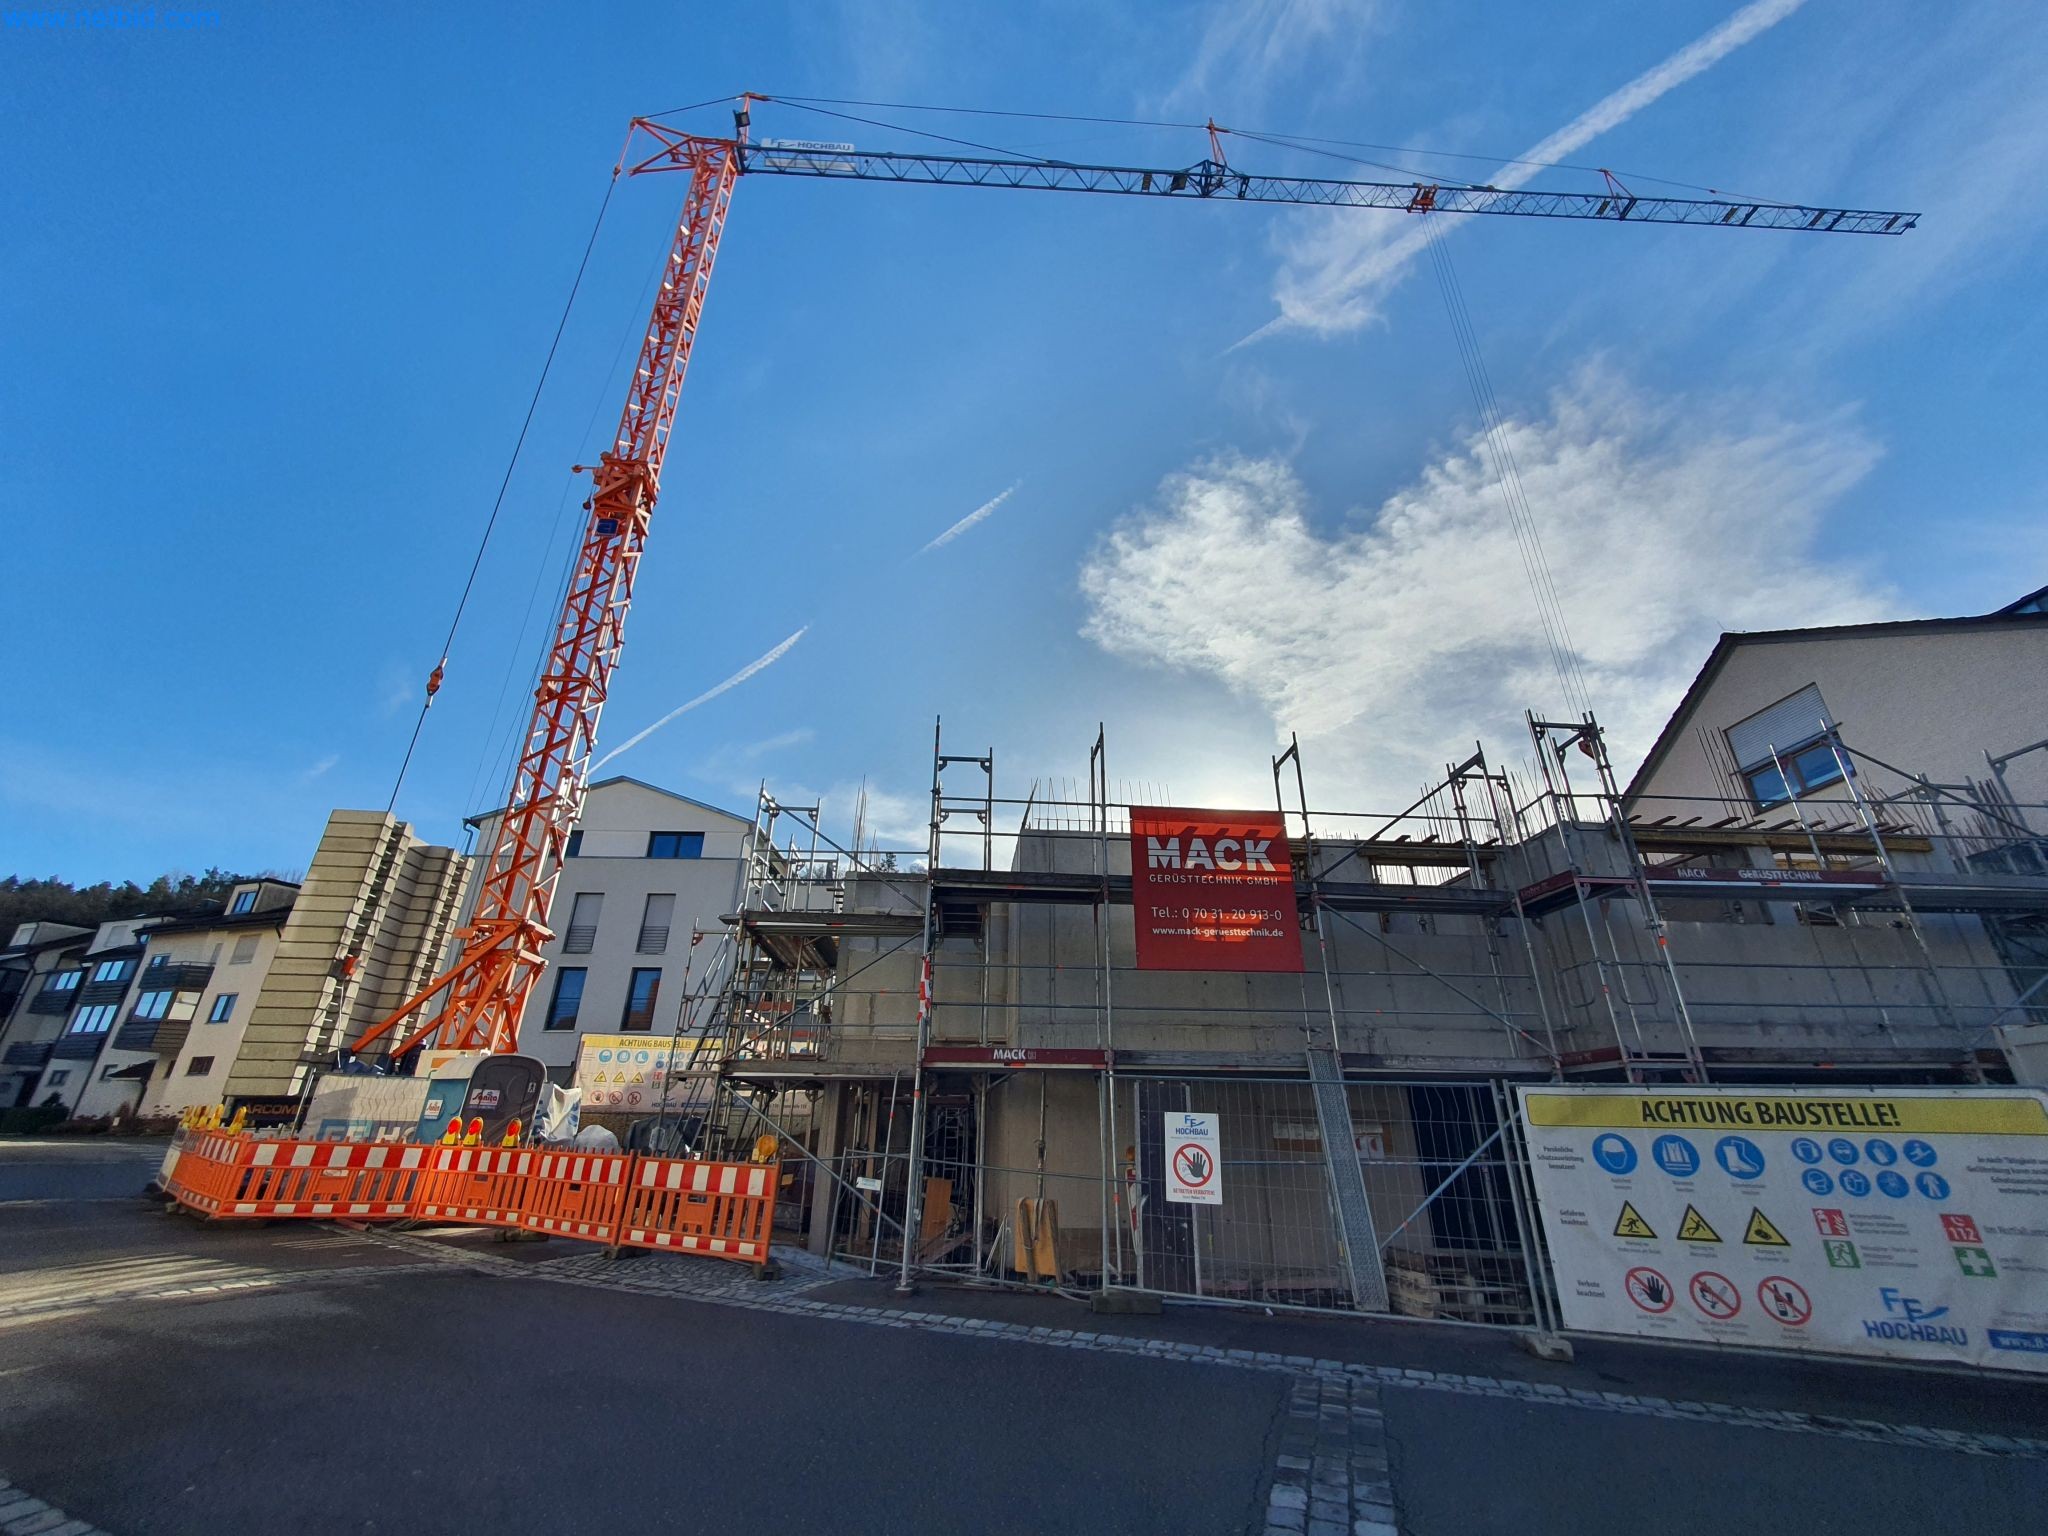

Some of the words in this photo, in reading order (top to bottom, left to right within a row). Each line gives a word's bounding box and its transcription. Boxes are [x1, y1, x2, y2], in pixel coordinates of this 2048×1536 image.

[798, 142, 850, 151] HOCHBAU
[1147, 836, 1276, 871] MACK
[1149, 873, 1243, 885] GERÜSTTECHNIK
[1247, 876, 1278, 885] GMBH
[1677, 868, 1707, 879] MACK
[1151, 906, 1178, 918] Tel.:
[1152, 927, 1284, 938] www.mack-geruesttechnik.de
[619, 1039, 652, 1048] ACHTUNG
[993, 1049, 1026, 1060] MACK
[1642, 1101, 1754, 1124] ACHTUNG
[1755, 1102, 1902, 1127] BAUSTELLE!
[1175, 1128, 1209, 1136] HOCHBAU
[1948, 1227, 1980, 1241] 112
[1862, 1319, 1968, 1346] HOCHBAU
